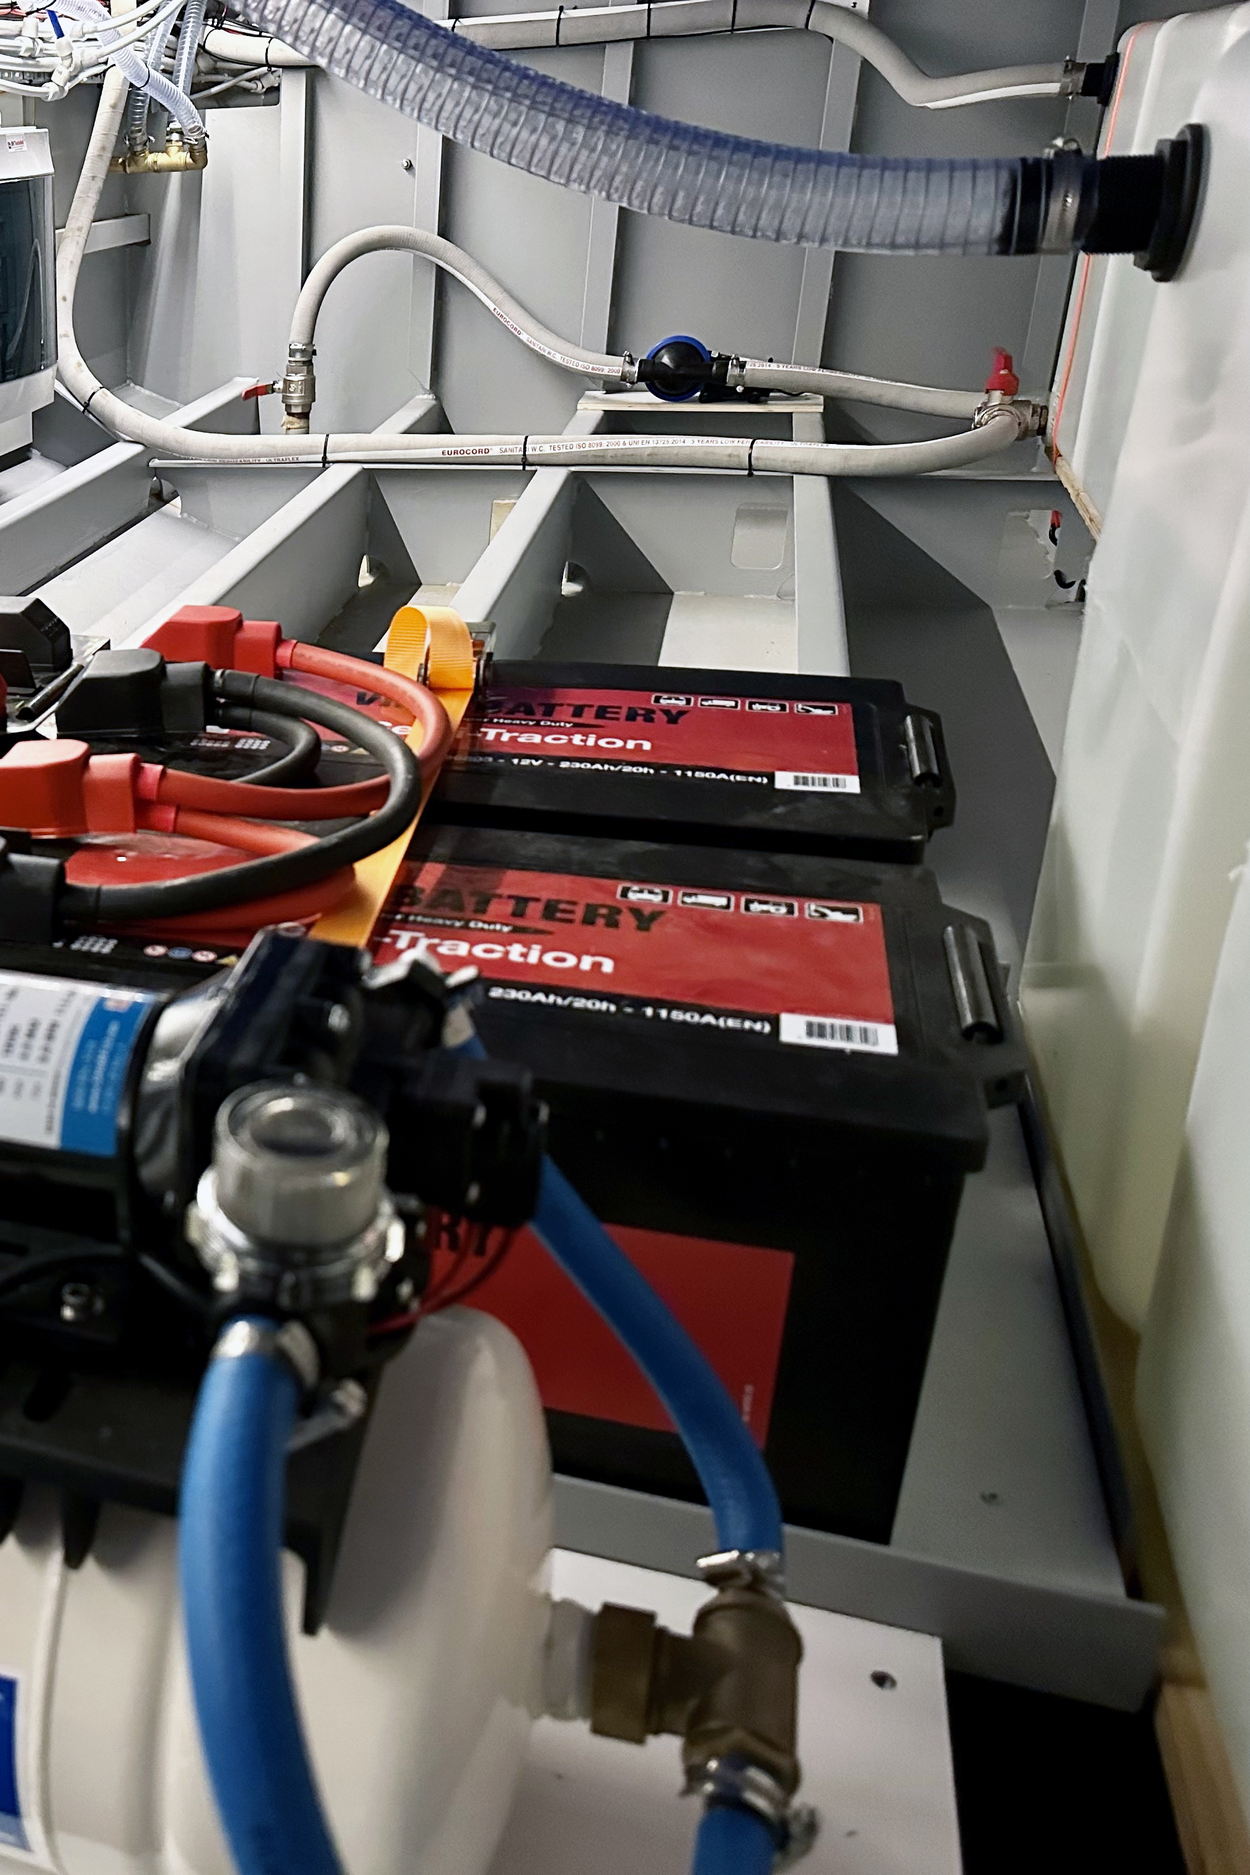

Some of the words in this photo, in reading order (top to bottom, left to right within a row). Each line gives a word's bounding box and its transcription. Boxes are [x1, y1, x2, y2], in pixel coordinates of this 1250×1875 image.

[493, 308, 522, 336] EUROCORD
[442, 448, 490, 456] EUROCORD
[500, 446, 530, 454] SANITAI
[550, 444, 574, 452] TESTED
[493, 717, 537, 728] Heavy
[540, 719, 574, 729] Duty
[469, 728, 652, 751] -Traction
[510, 757, 543, 766] 12V
[674, 768, 768, 784] 1150A(EN)
[408, 915, 463, 928] Heavy
[468, 920, 513, 932] Duty
[374, 929, 616, 973] -Traction
[488, 986, 617, 1014] 230Ah/20h
[641, 1005, 772, 1035] 1150A(EN)
